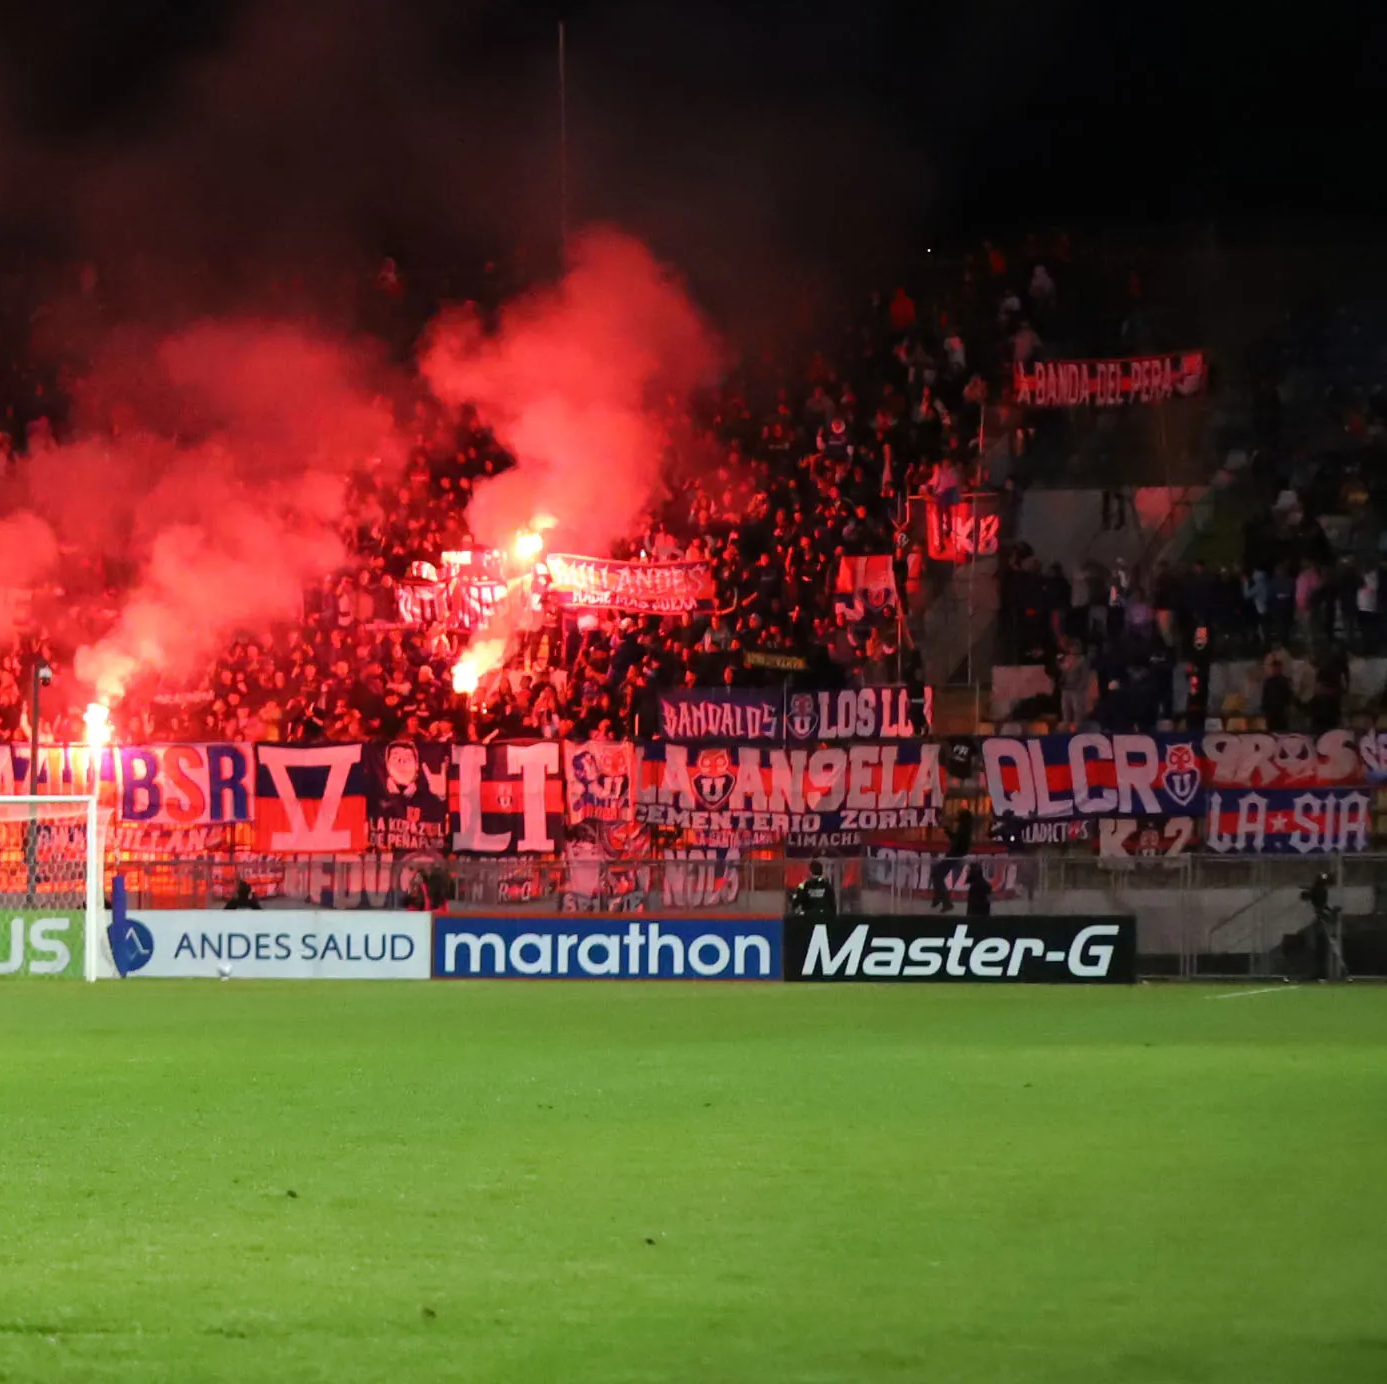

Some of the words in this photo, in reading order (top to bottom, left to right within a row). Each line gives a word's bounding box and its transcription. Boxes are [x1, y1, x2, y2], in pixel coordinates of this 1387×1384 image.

[818, 688, 876, 738] LOS
[120, 746, 251, 822] BSR
[173, 931, 296, 961] ANDES
[301, 931, 415, 962] SALUD
[444, 923, 771, 976] marathon
[801, 924, 1120, 977] Master-G
